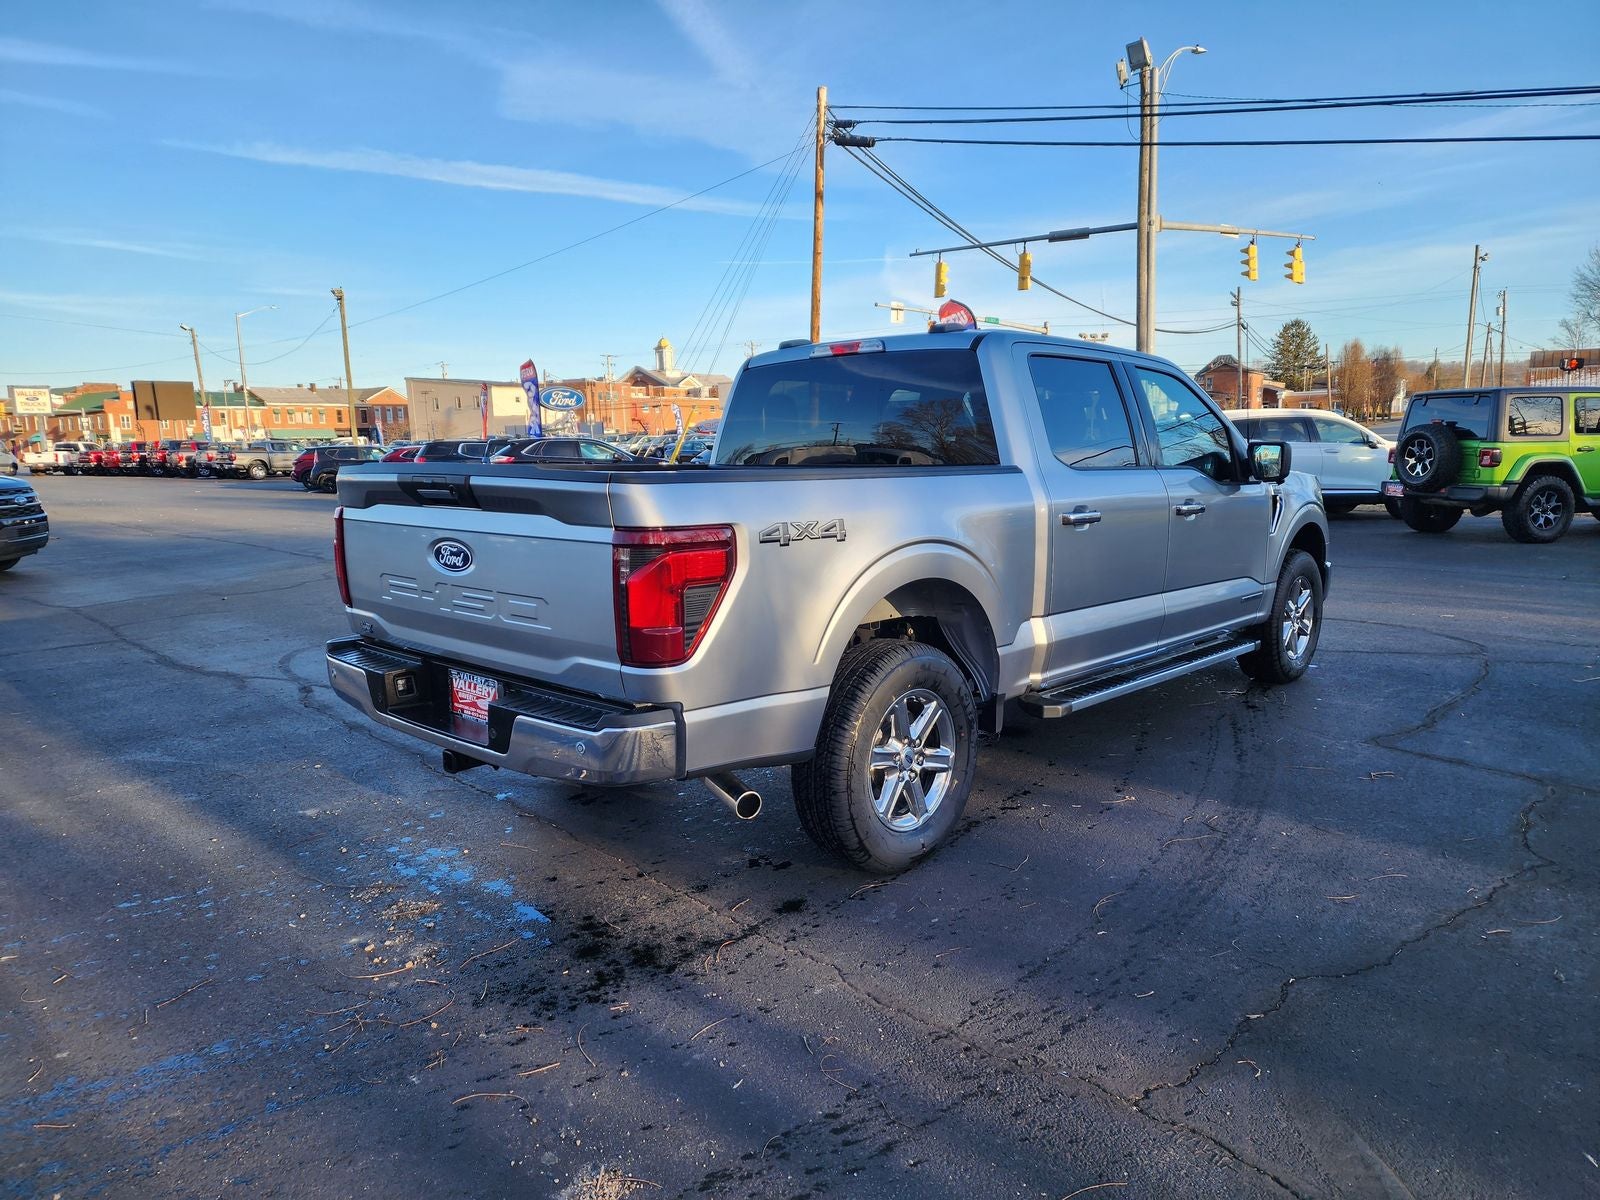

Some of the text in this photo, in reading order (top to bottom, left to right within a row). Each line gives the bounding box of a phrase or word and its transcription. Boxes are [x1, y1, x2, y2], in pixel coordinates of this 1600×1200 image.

[549, 390, 577, 406] Ford
[437, 544, 465, 568] Ford
[379, 572, 552, 630] F-150
[452, 678, 496, 702] VALLERY
